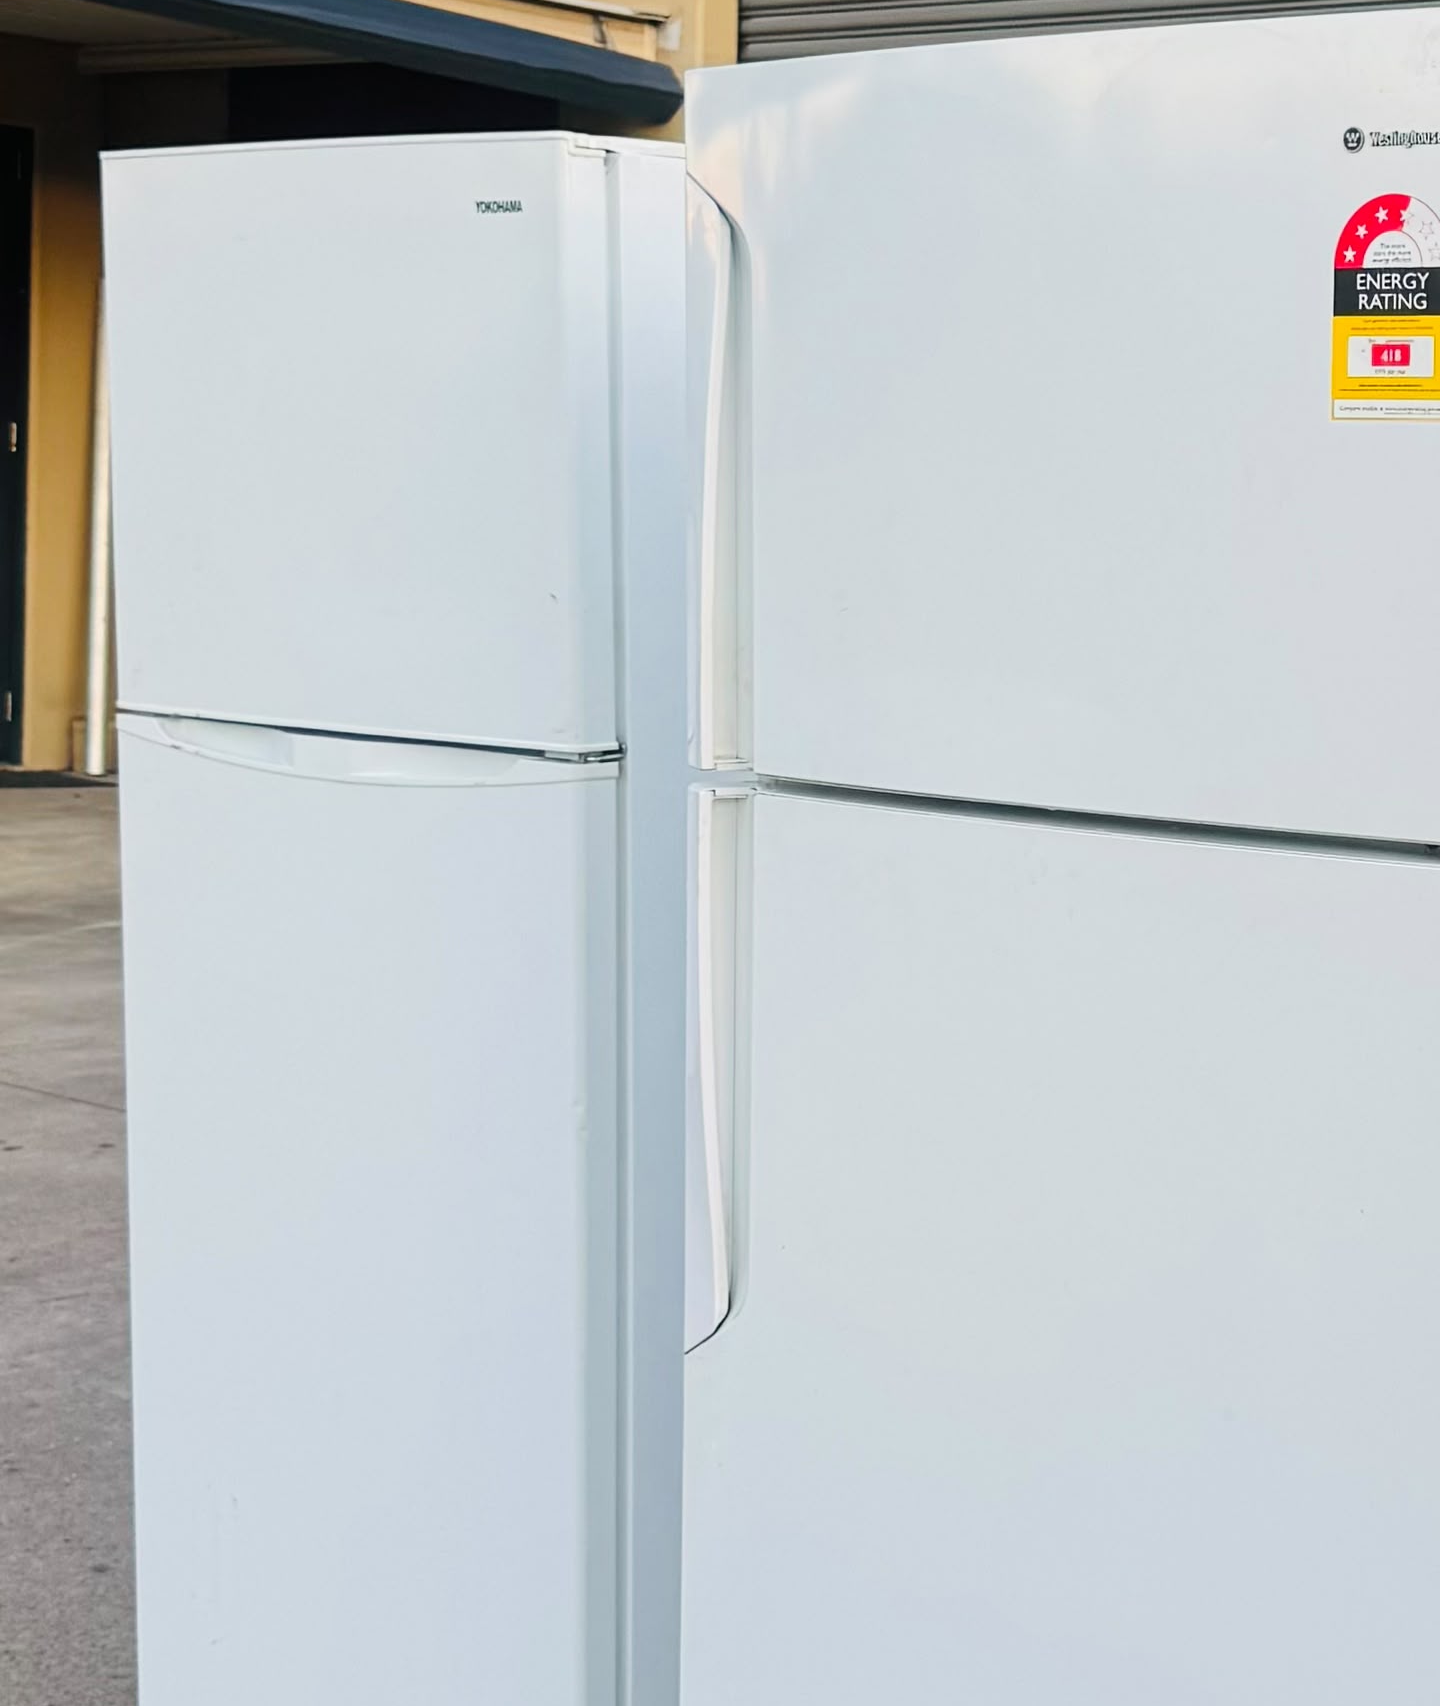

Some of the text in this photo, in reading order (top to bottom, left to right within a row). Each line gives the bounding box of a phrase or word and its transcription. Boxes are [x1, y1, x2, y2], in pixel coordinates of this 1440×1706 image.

[475, 200, 523, 214] YOKOHAMA
[1356, 272, 1430, 291] ENERGY
[1358, 292, 1427, 310] RATING
